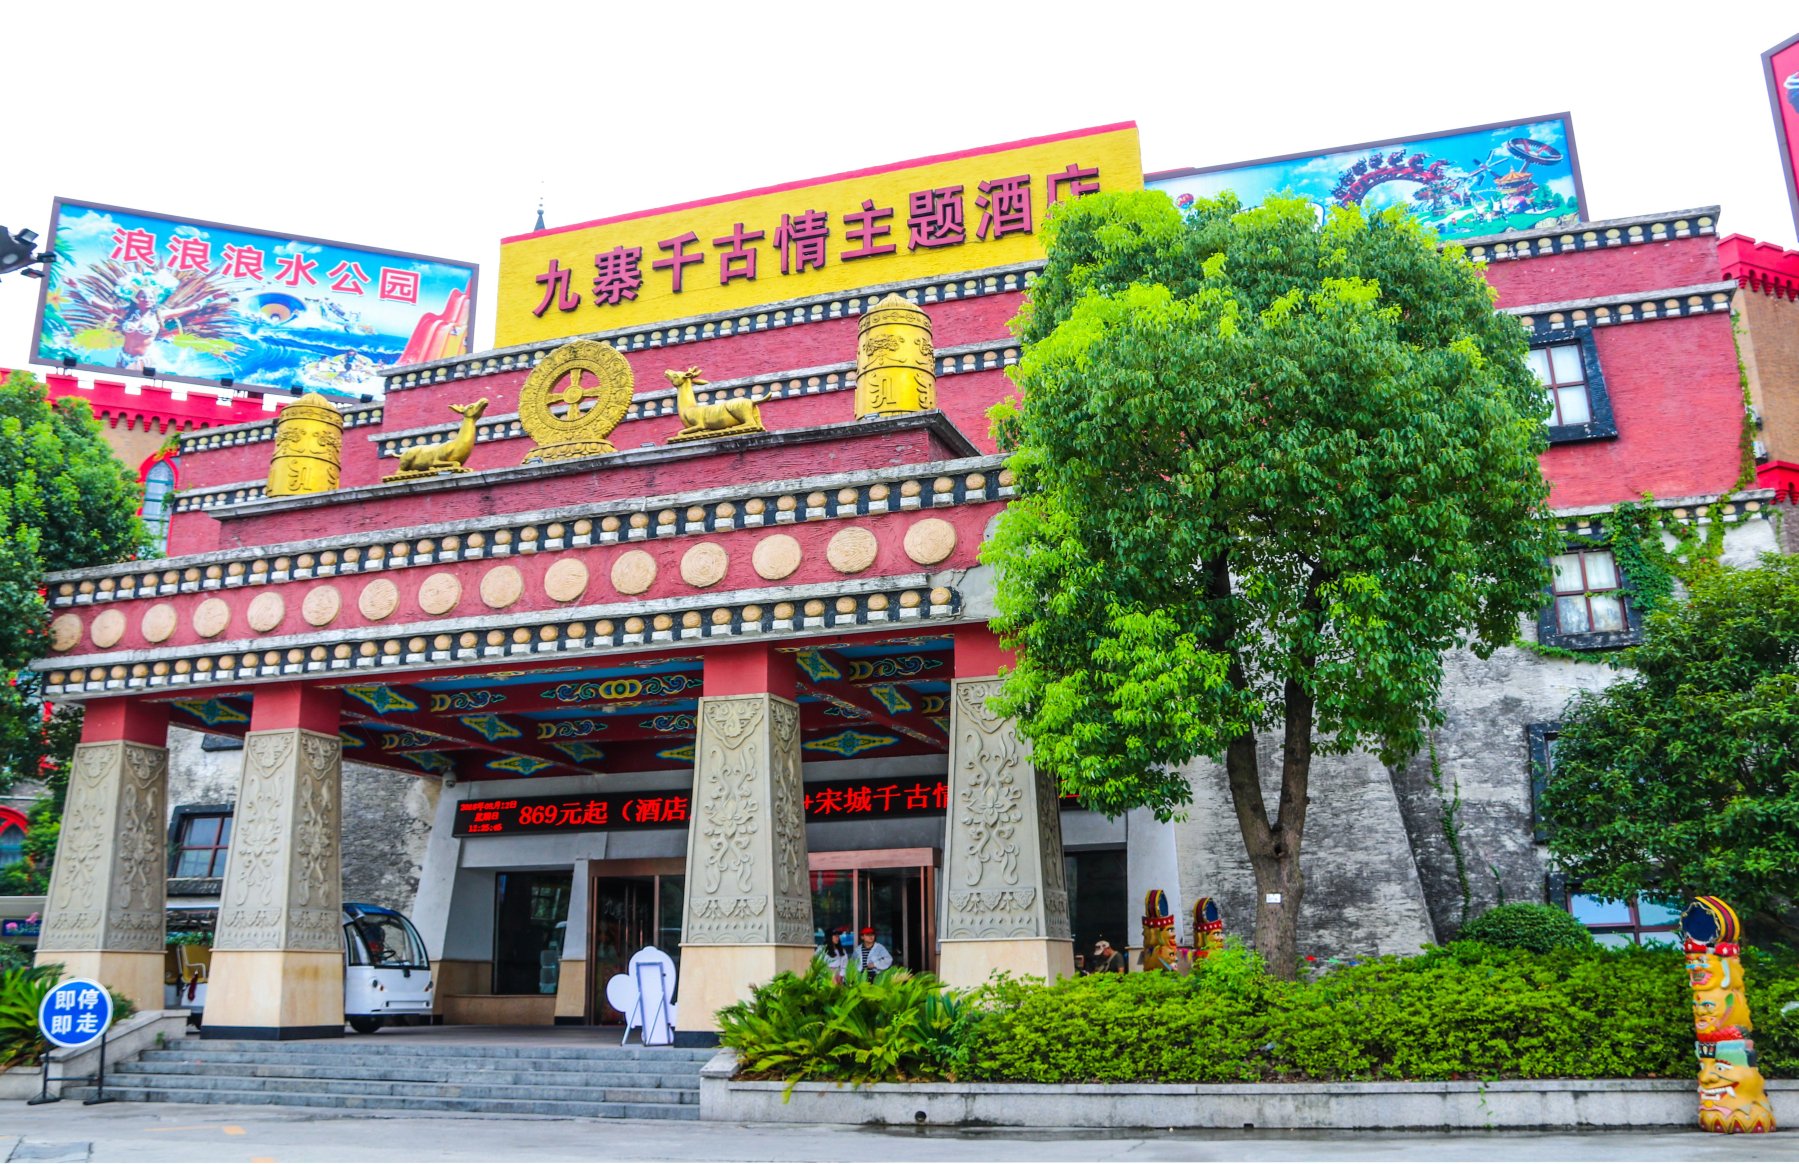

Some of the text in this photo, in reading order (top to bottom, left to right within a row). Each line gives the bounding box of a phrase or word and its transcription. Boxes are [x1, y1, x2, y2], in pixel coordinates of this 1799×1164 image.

[532, 163, 1100, 318] 九寨千古情主题酒店
[110, 227, 421, 305] 浪浪浪水公园
[518, 796, 692, 826] 869元起（酒店
[55, 989, 99, 1011] 即停
[51, 1012, 98, 1035] 即走
